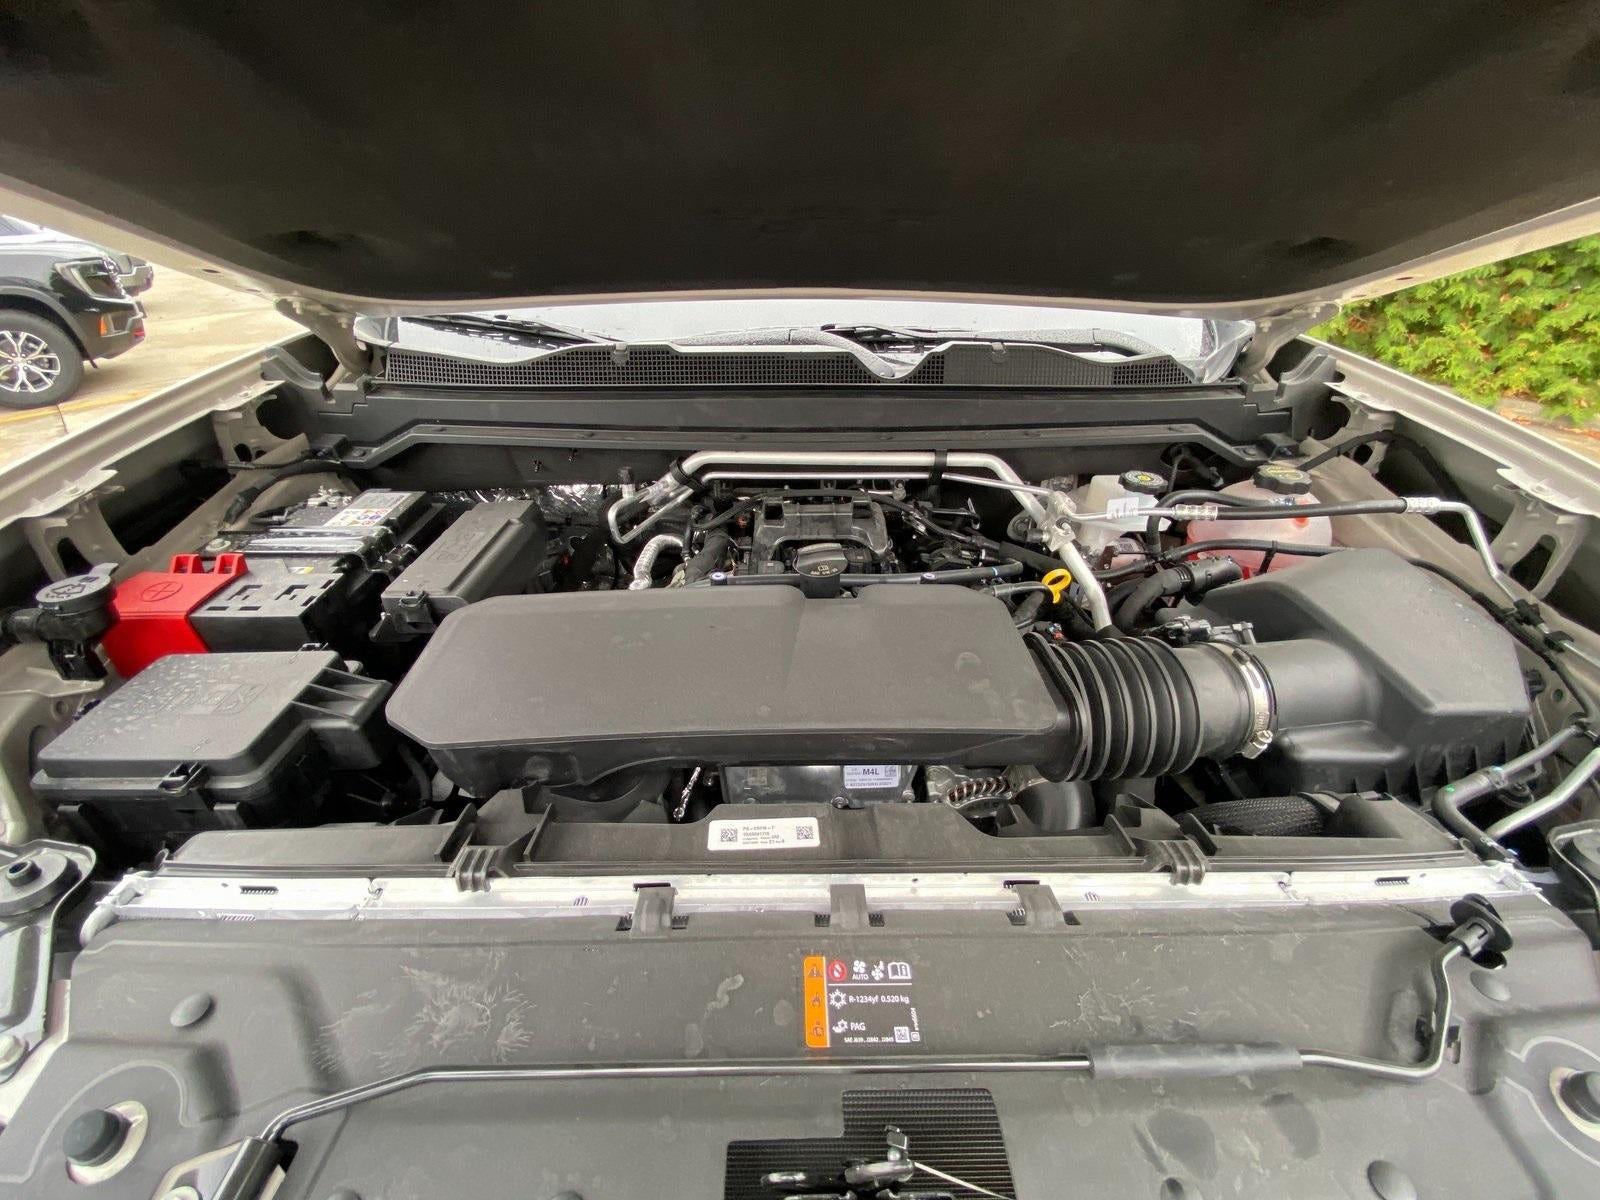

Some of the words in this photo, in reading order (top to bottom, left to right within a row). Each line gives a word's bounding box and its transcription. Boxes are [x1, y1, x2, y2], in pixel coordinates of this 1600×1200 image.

[848, 995, 878, 1004] R-1234yf
[880, 995, 899, 1003] 0.520
[900, 995, 909, 1004] kg
[850, 1022, 866, 1030] PAG
